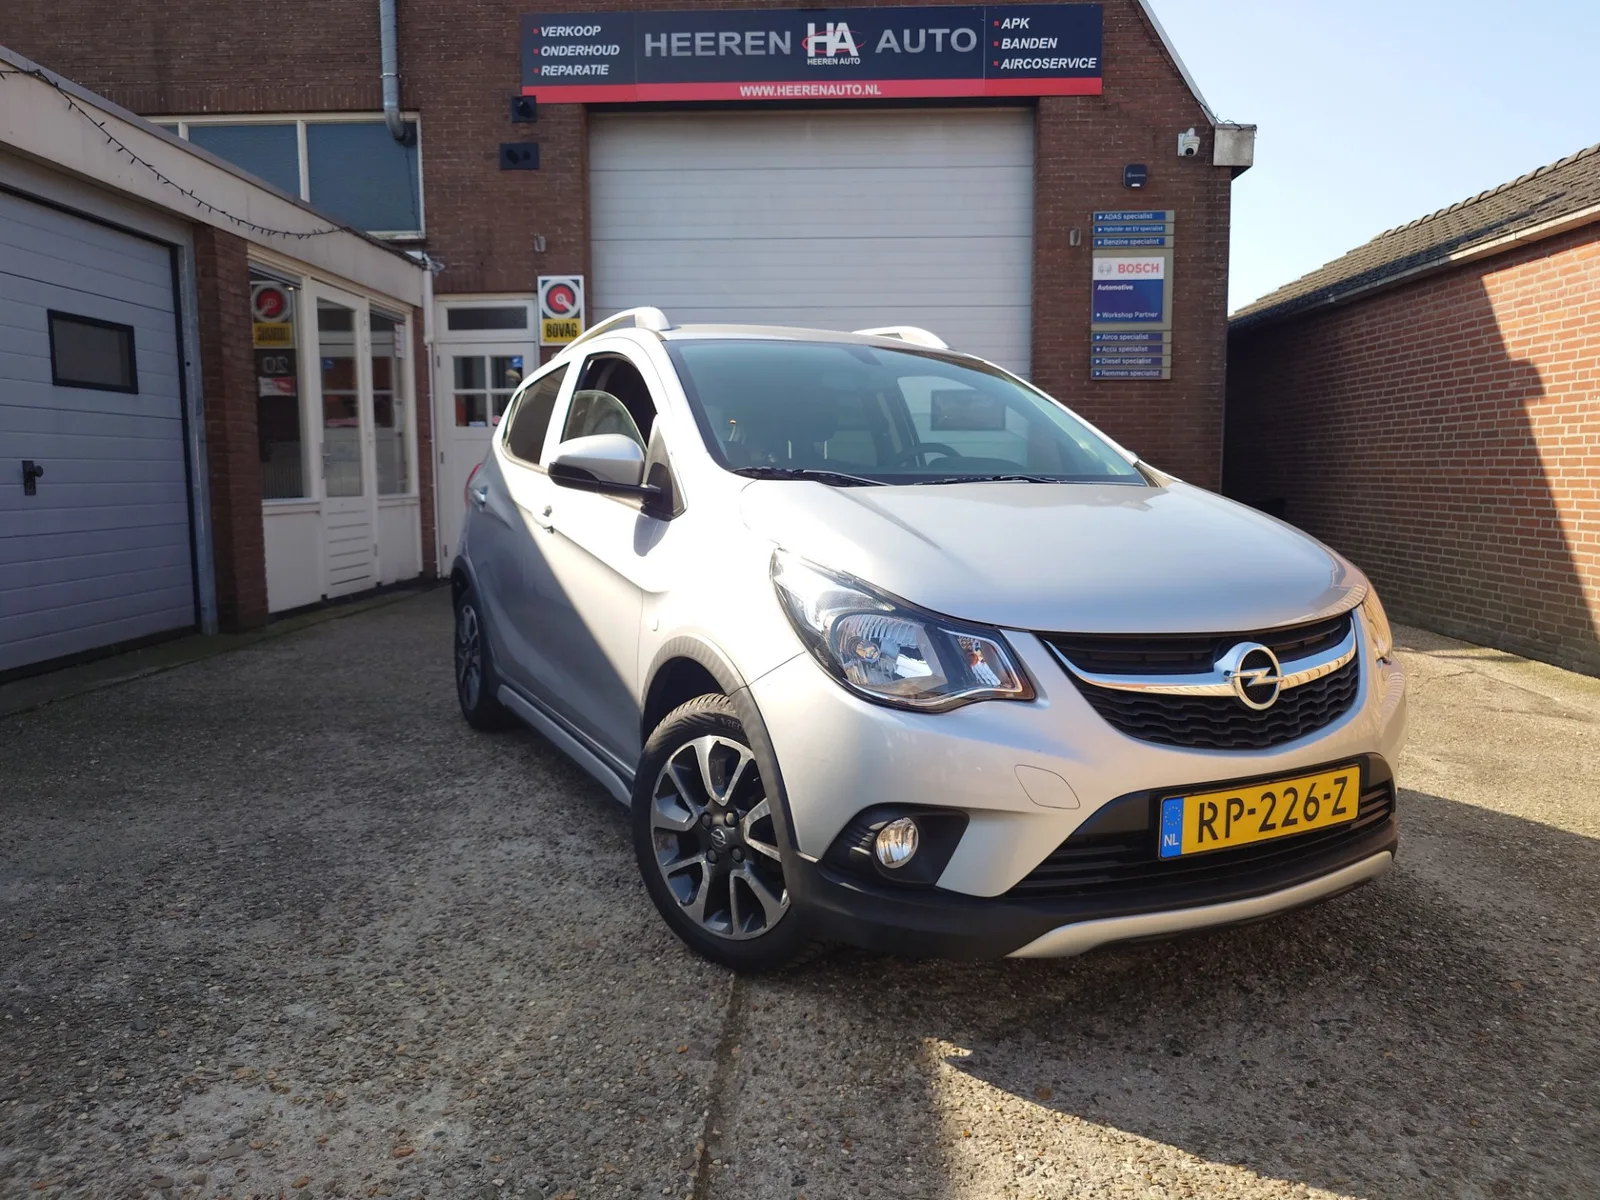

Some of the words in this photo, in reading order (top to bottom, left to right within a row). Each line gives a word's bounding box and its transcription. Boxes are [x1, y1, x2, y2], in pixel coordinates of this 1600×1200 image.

[1001, 18, 1030, 30] APK
[540, 25, 601, 37] VERKOOP
[644, 31, 792, 57] HEEREN
[875, 28, 977, 54] AUTO
[807, 22, 859, 58] HA
[1001, 37, 1058, 50] BANDEN
[540, 45, 620, 57] ONDERHOUD
[807, 58, 837, 66] HEEREN
[839, 57, 861, 65] AUTO
[1001, 57, 1097, 70] AIRCOSERVICE
[540, 64, 610, 77] REPARATIE
[739, 84, 882, 97] WWW.HEERENAUTO.NL
[1117, 263, 1159, 274] BOSCH
[545, 322, 577, 338] BOVAG
[1119, 333, 1149, 341] specialist
[1118, 345, 1148, 353] specialist
[1197, 776, 1348, 843] RP-226-Z
[1163, 833, 1179, 847] NL
